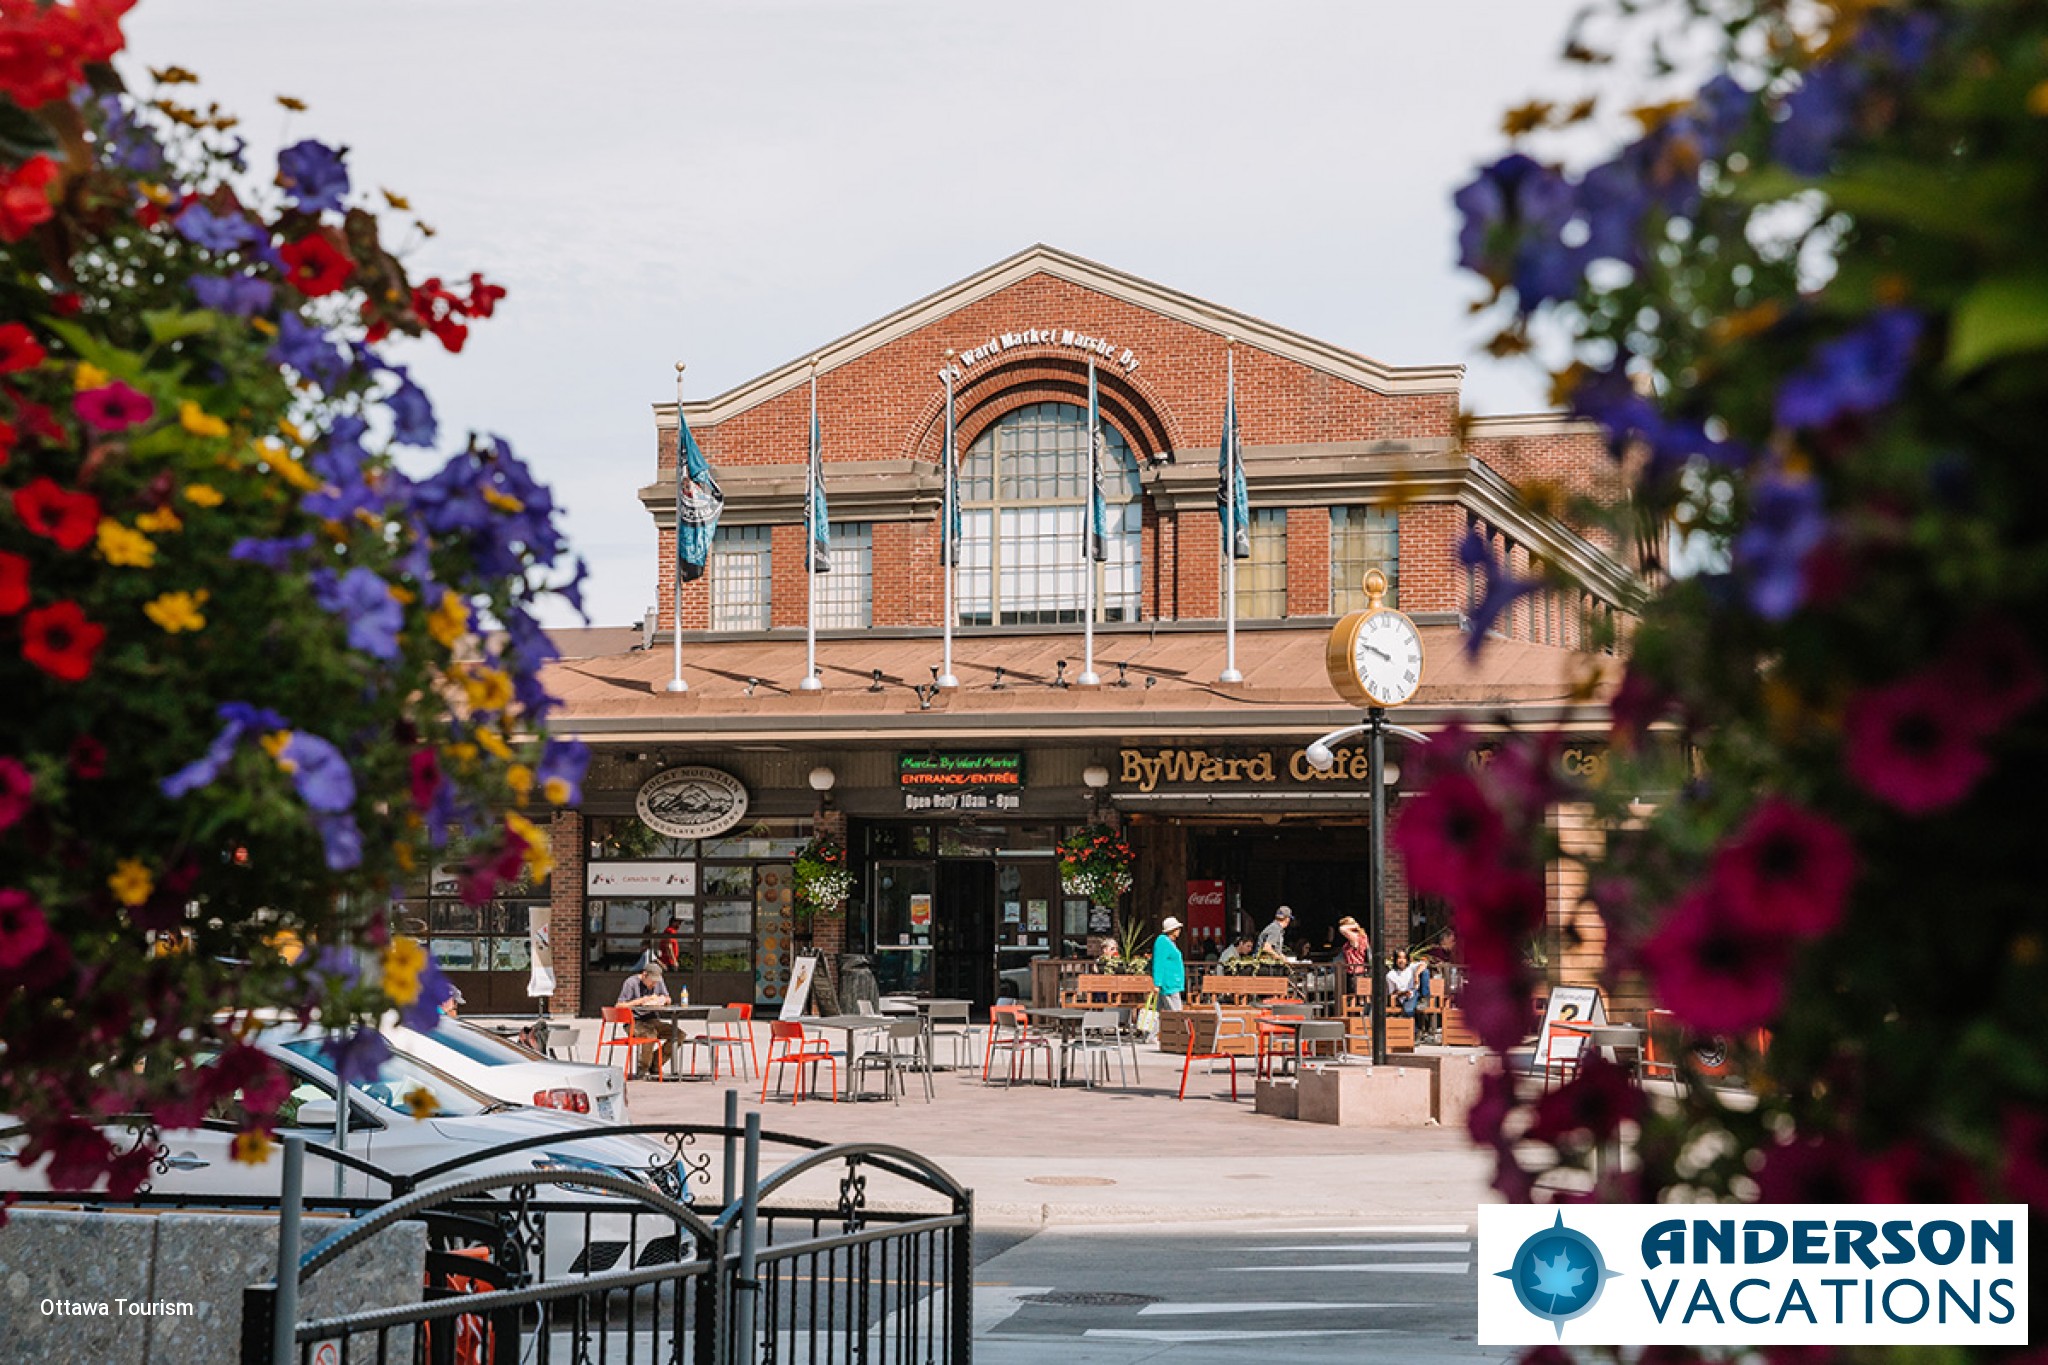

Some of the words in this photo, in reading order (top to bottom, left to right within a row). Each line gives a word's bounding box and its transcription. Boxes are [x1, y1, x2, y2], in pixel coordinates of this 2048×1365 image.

[960, 338, 999, 367] Ward
[1000, 328, 1057, 350] Market
[1119, 348, 1140, 373] By
[939, 757, 955, 771] By
[1120, 748, 1276, 792] ByWard
[641, 769, 678, 796] ROCKY
[681, 768, 743, 793] MOUNTAIN
[905, 794, 931, 809] Open
[932, 794, 958, 810] Daily
